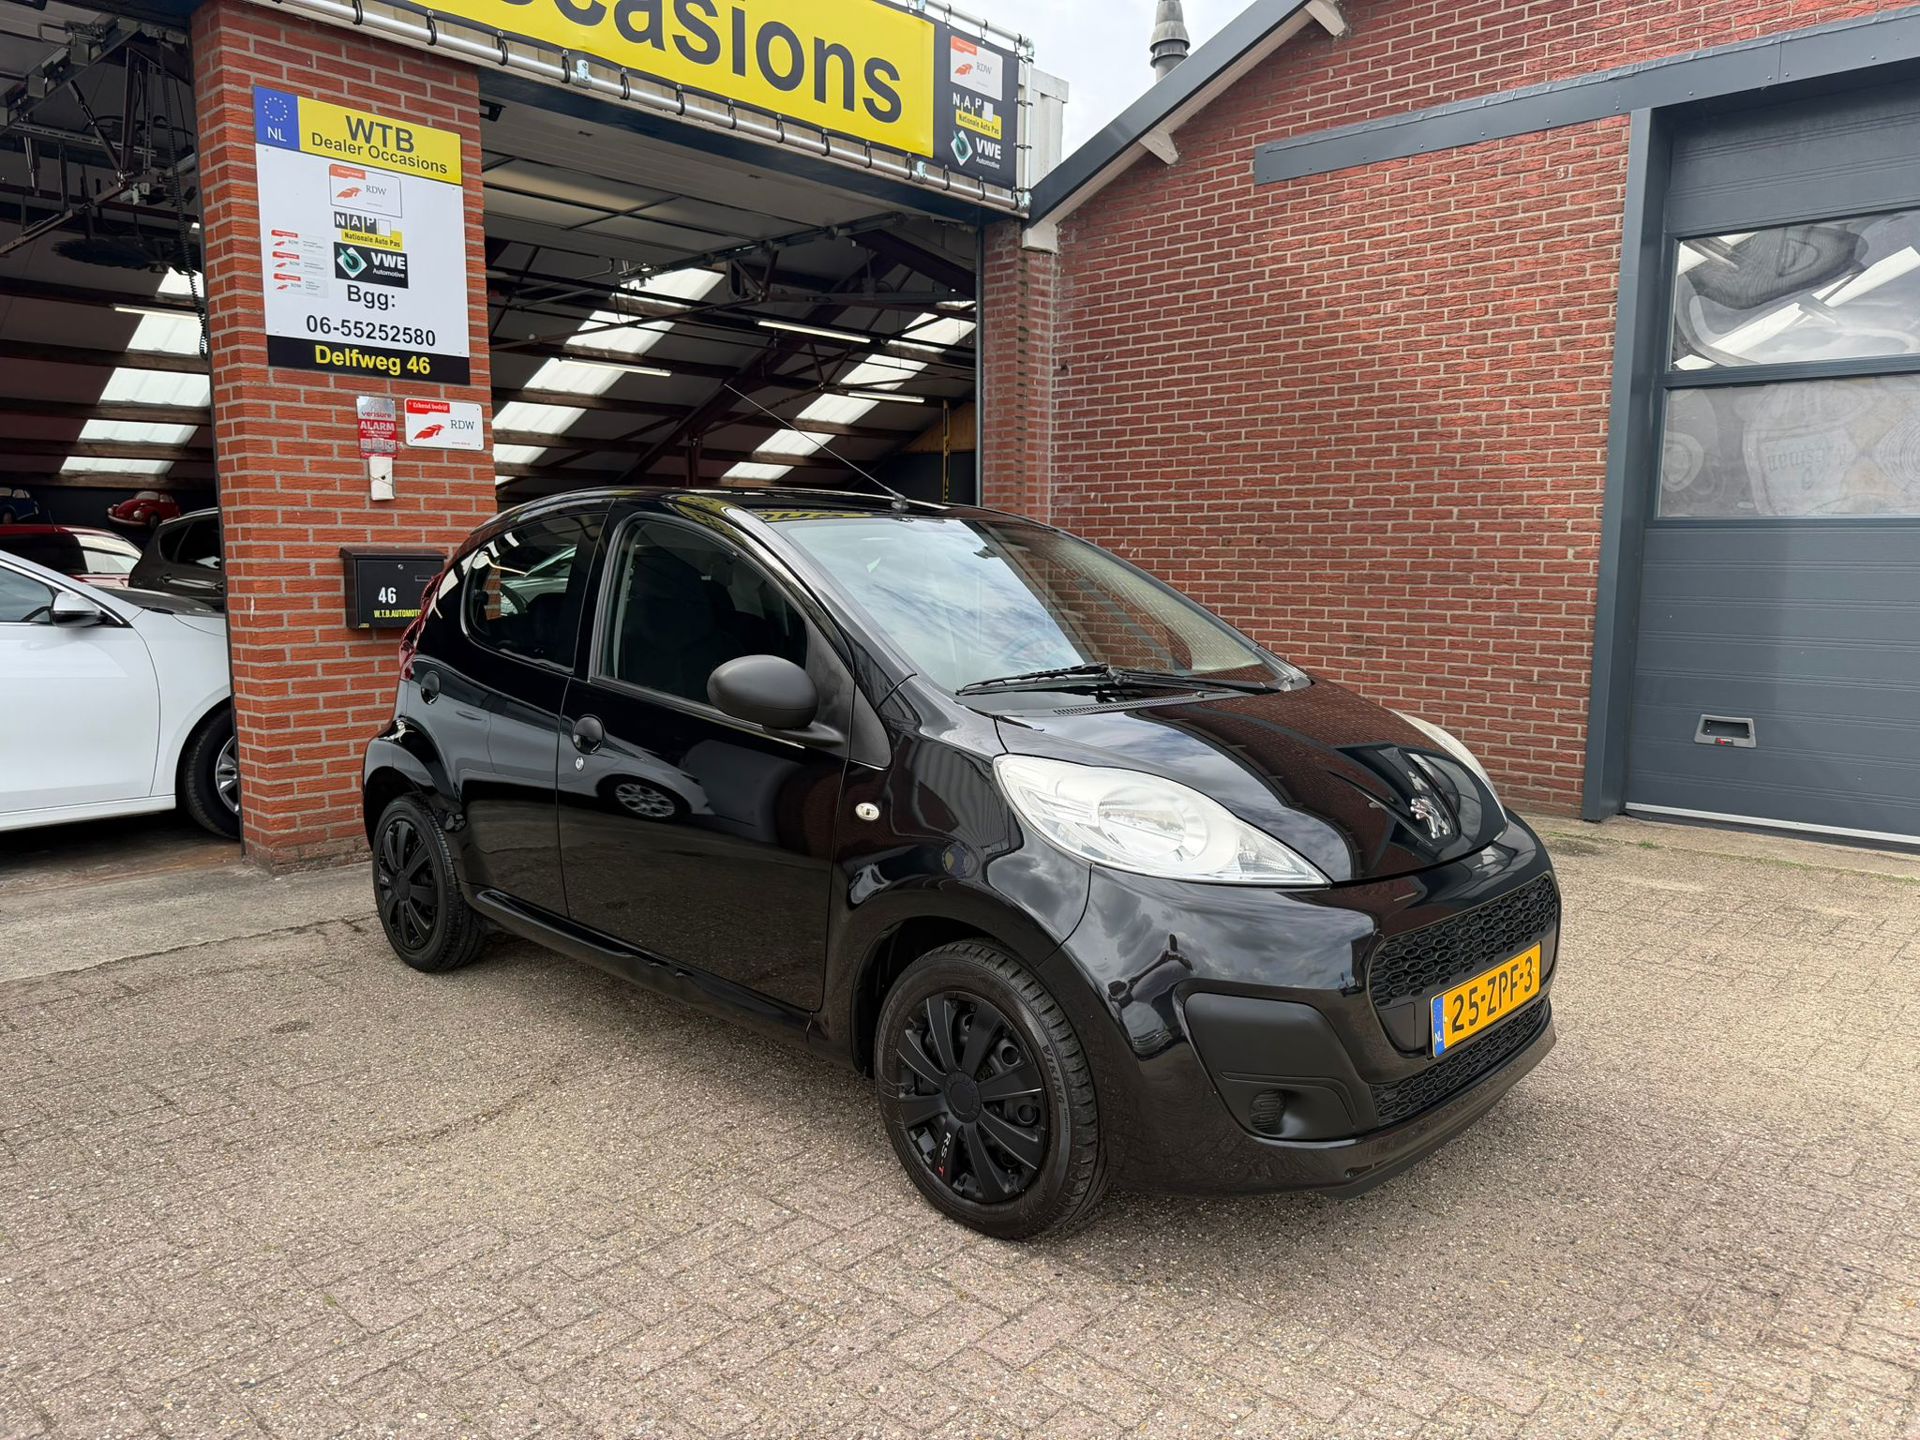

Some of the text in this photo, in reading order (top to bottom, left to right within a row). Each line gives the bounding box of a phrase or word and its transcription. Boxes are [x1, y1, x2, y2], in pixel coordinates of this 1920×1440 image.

[501, 0, 902, 124] asions
[266, 126, 287, 142] NL
[345, 115, 415, 153] WTB
[311, 132, 448, 174] Dealer Occasions
[975, 136, 1002, 160] VWE
[365, 184, 387, 196] RDW
[344, 231, 401, 248] Nationale Auto Pas
[370, 251, 407, 270] VWE
[372, 267, 406, 280] Automotive
[346, 284, 397, 311] Bgg:
[306, 314, 437, 347] 06-55252580
[314, 344, 432, 377] Delfweg 46
[359, 420, 396, 432] ALARM
[450, 419, 475, 430] RDW
[377, 586, 397, 604] 46
[1451, 955, 1533, 1035] 25-ZPF-3
[1434, 1031, 1443, 1044] NL
[1041, 1043, 1065, 1104] VIKING
